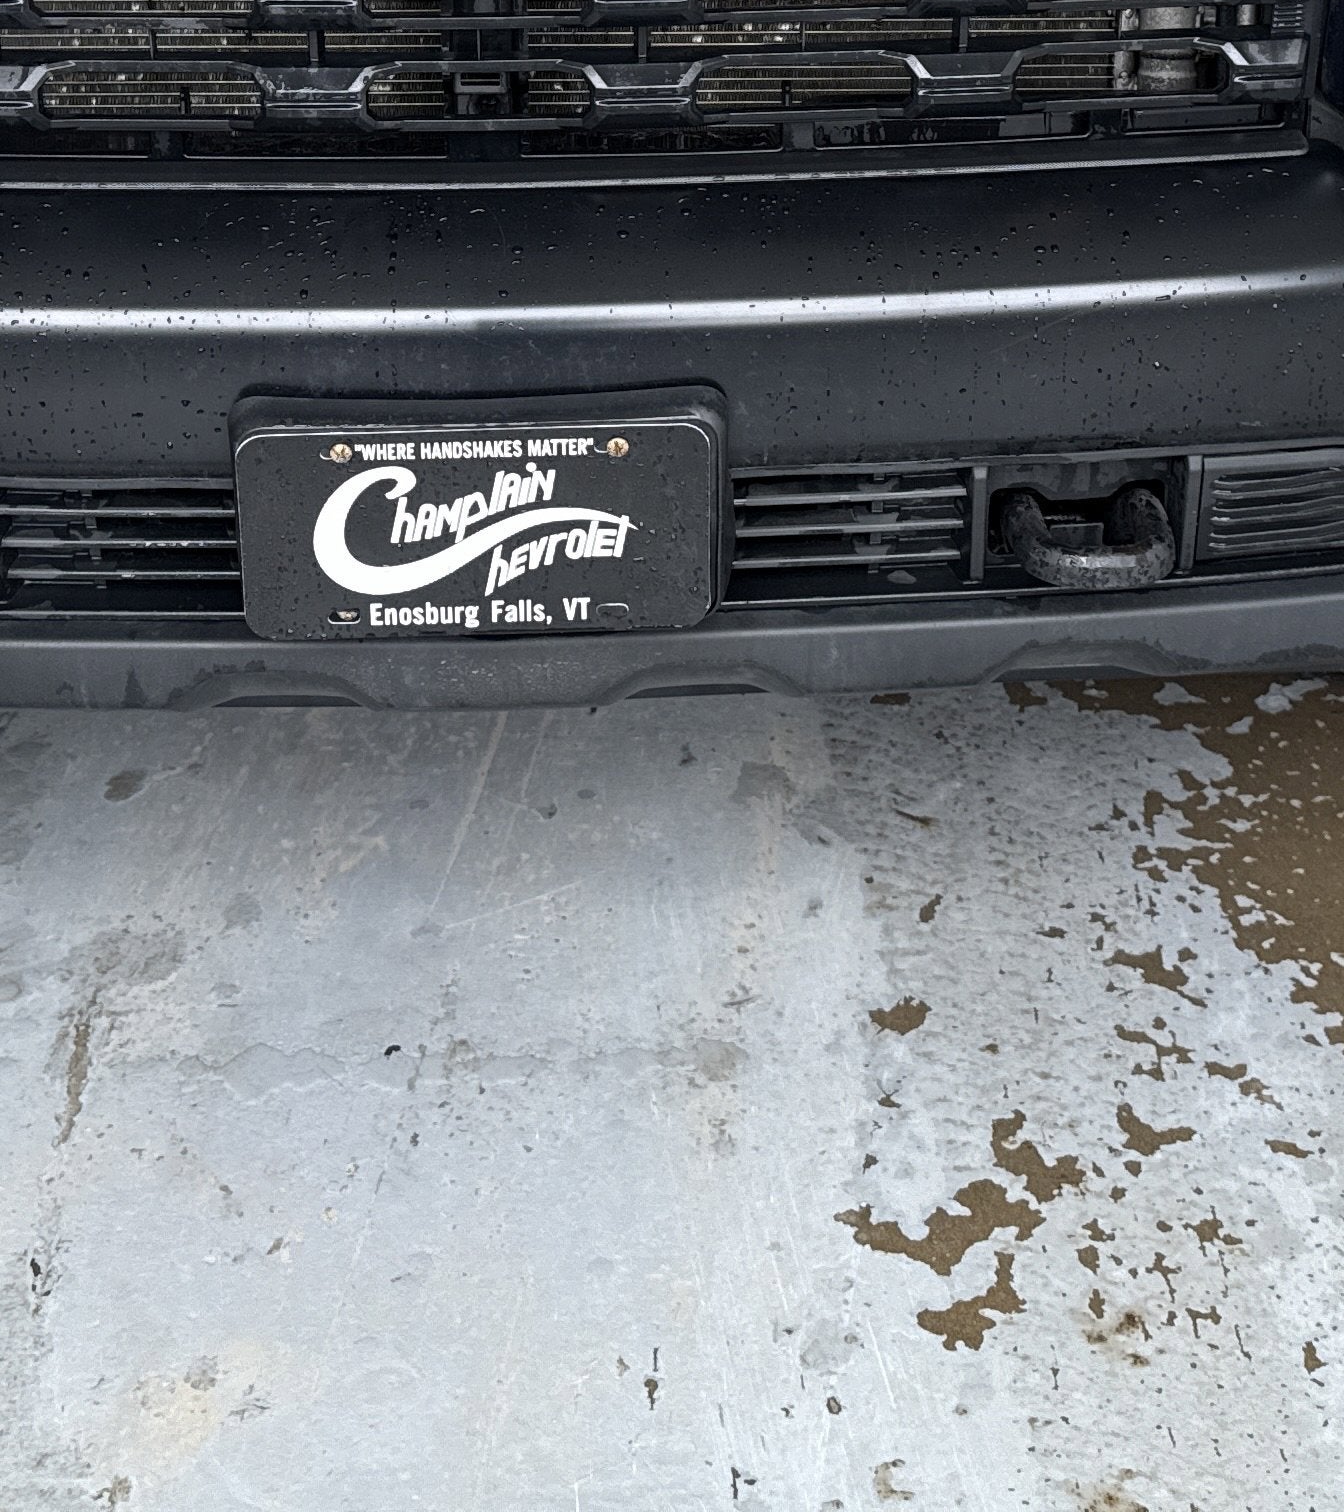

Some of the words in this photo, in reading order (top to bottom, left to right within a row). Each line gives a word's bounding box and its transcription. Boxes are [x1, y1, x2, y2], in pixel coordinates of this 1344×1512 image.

[354, 443, 416, 461] "WHERE
[420, 440, 523, 460] HANDSHAKES
[527, 438, 594, 457] MATTER"
[369, 603, 480, 628] Enosburg
[490, 599, 553, 625] Falls,
[563, 597, 591, 620] VT
